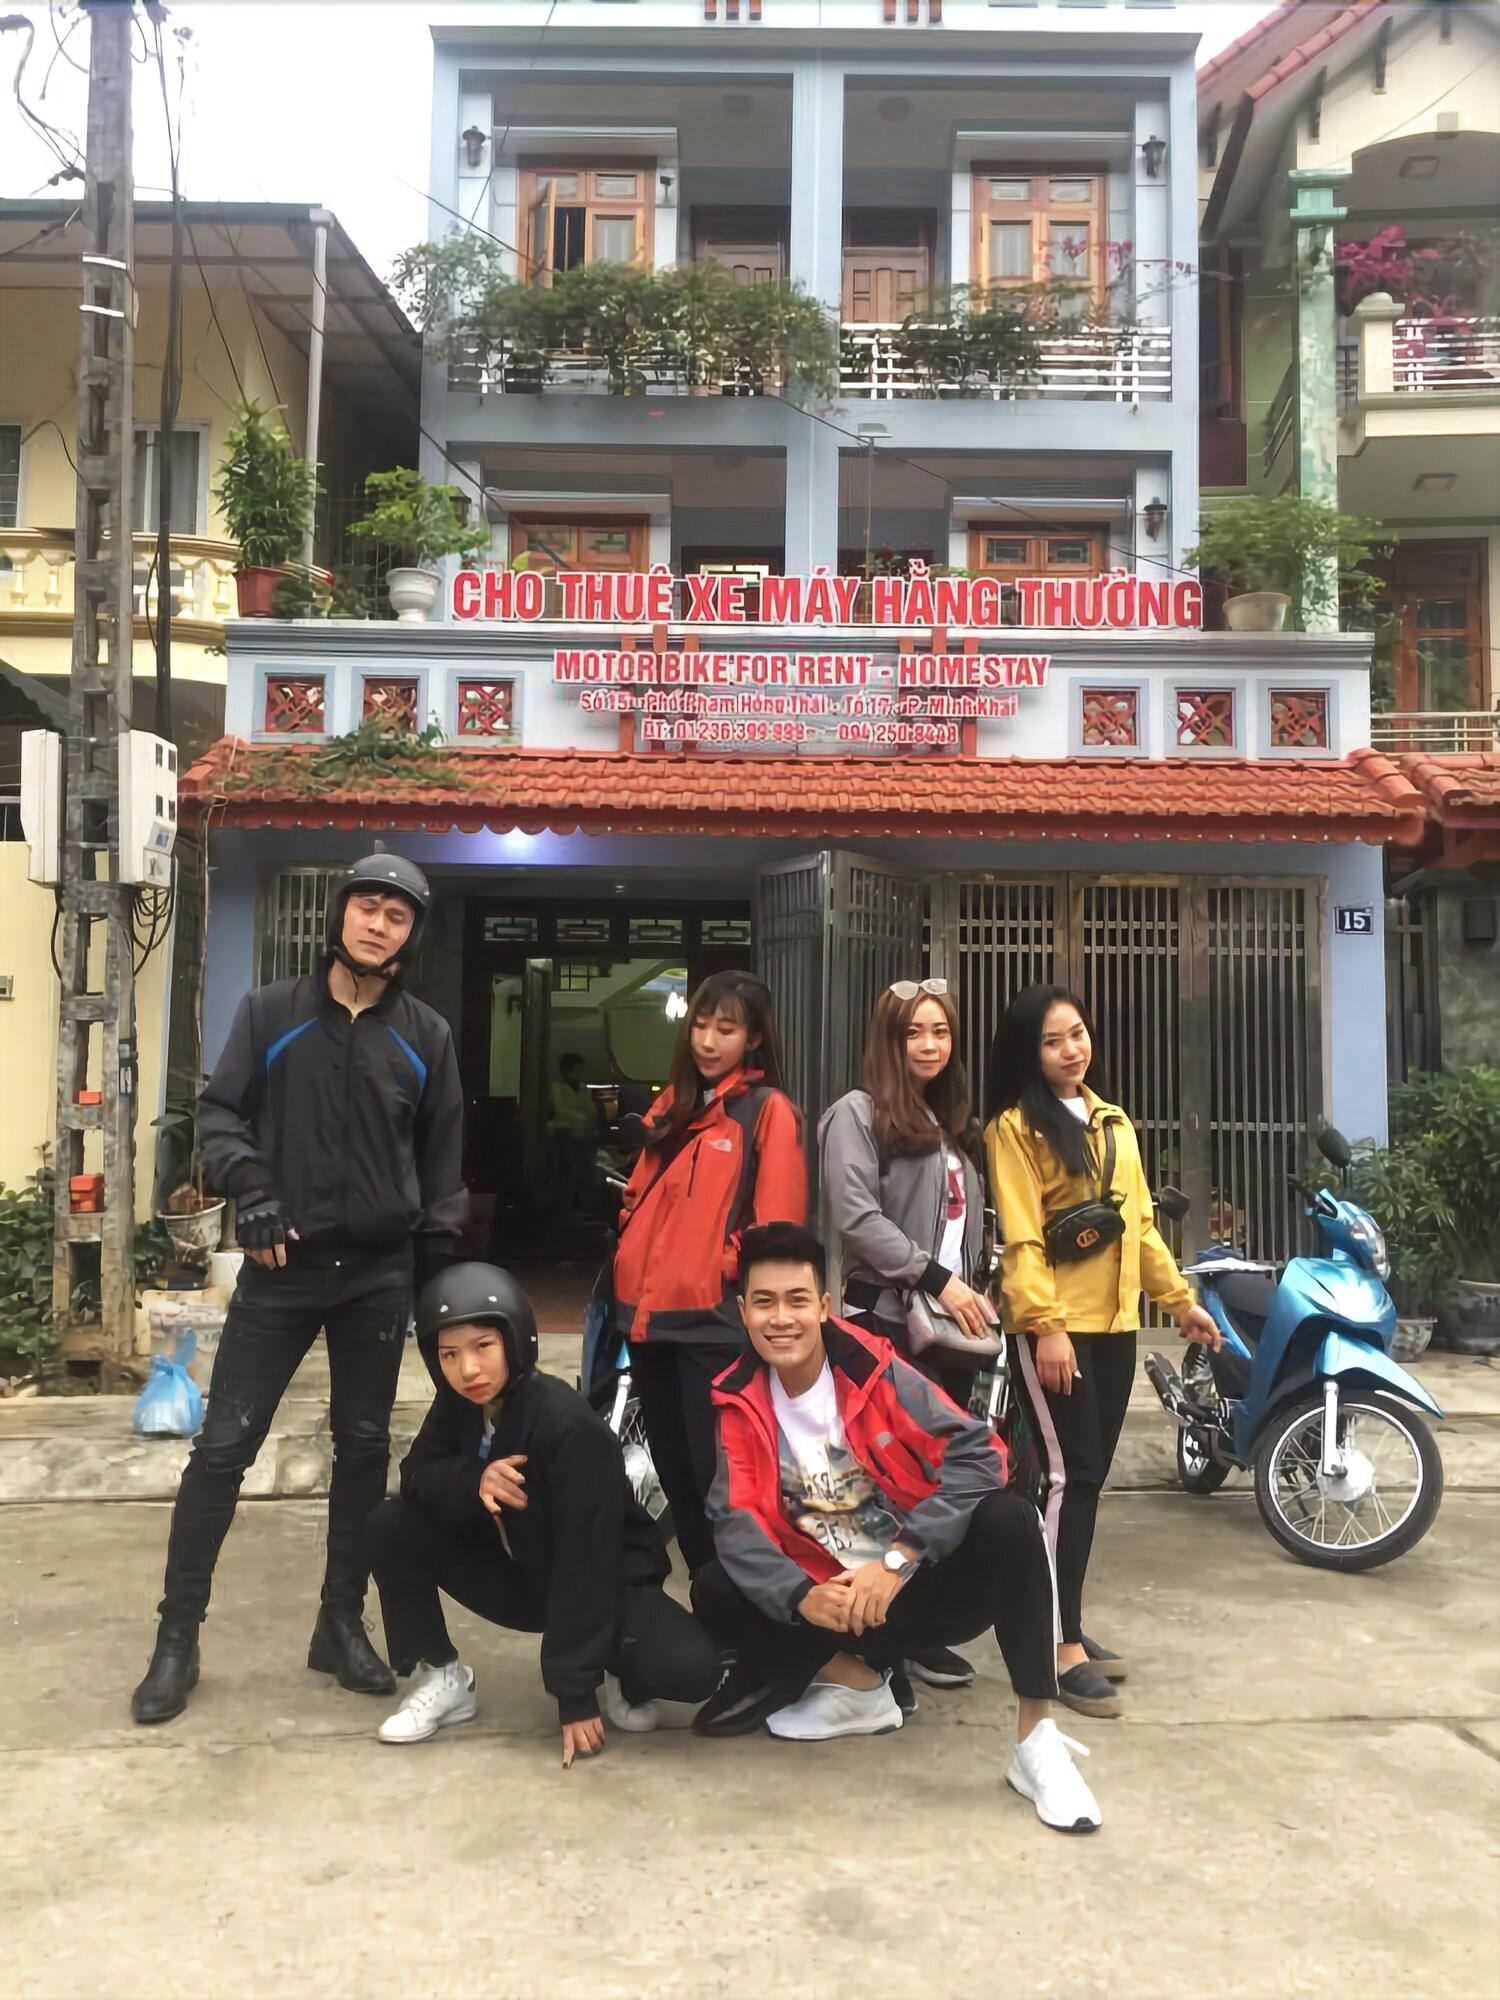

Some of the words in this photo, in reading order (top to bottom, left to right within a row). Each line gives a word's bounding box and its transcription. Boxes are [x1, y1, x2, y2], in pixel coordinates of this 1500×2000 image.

[453, 572, 543, 619] CHO
[557, 565, 672, 621] THUÊ
[687, 575, 745, 621] XE
[762, 567, 858, 623] MÁY
[736, 653, 788, 684] FOR
[798, 655, 871, 685] RENT
[900, 655, 1049, 686] HOMESTAY
[1344, 911, 1370, 929] 15
